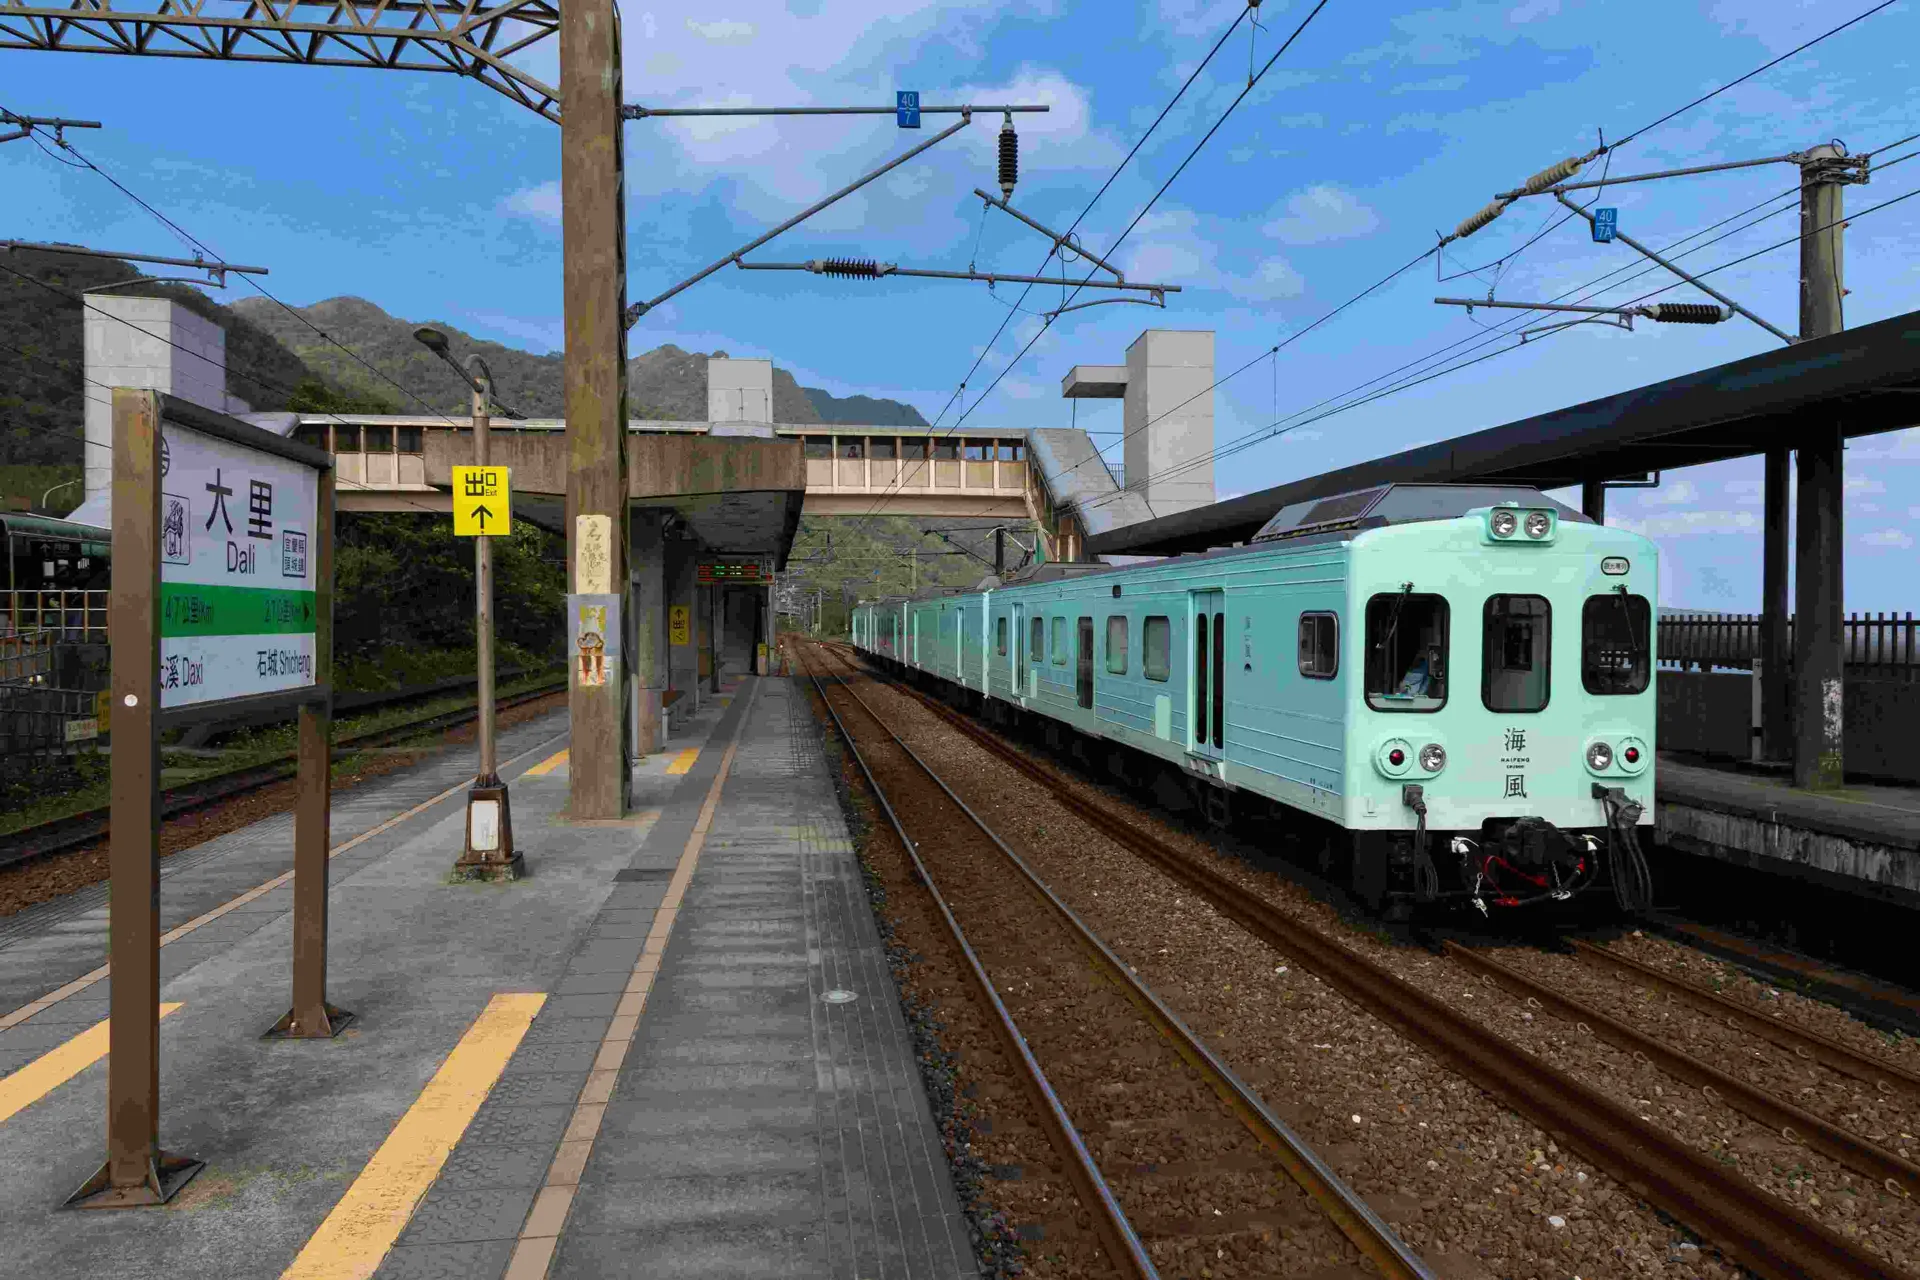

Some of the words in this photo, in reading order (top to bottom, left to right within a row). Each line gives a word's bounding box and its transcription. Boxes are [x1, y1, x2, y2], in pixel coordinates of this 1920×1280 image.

[901, 93, 914, 107] 40
[905, 111, 911, 125] 7
[1599, 209, 1613, 222] 40
[1598, 226, 1612, 238] 7A
[465, 472, 497, 496] 出口
[485, 488, 498, 497] Exit
[205, 467, 273, 540] 大里
[226, 540, 256, 575] Dali
[160, 654, 179, 690] 溪
[182, 655, 203, 686] Daxi
[257, 648, 278, 678] 石城
[279, 650, 311, 678] Shicheng
